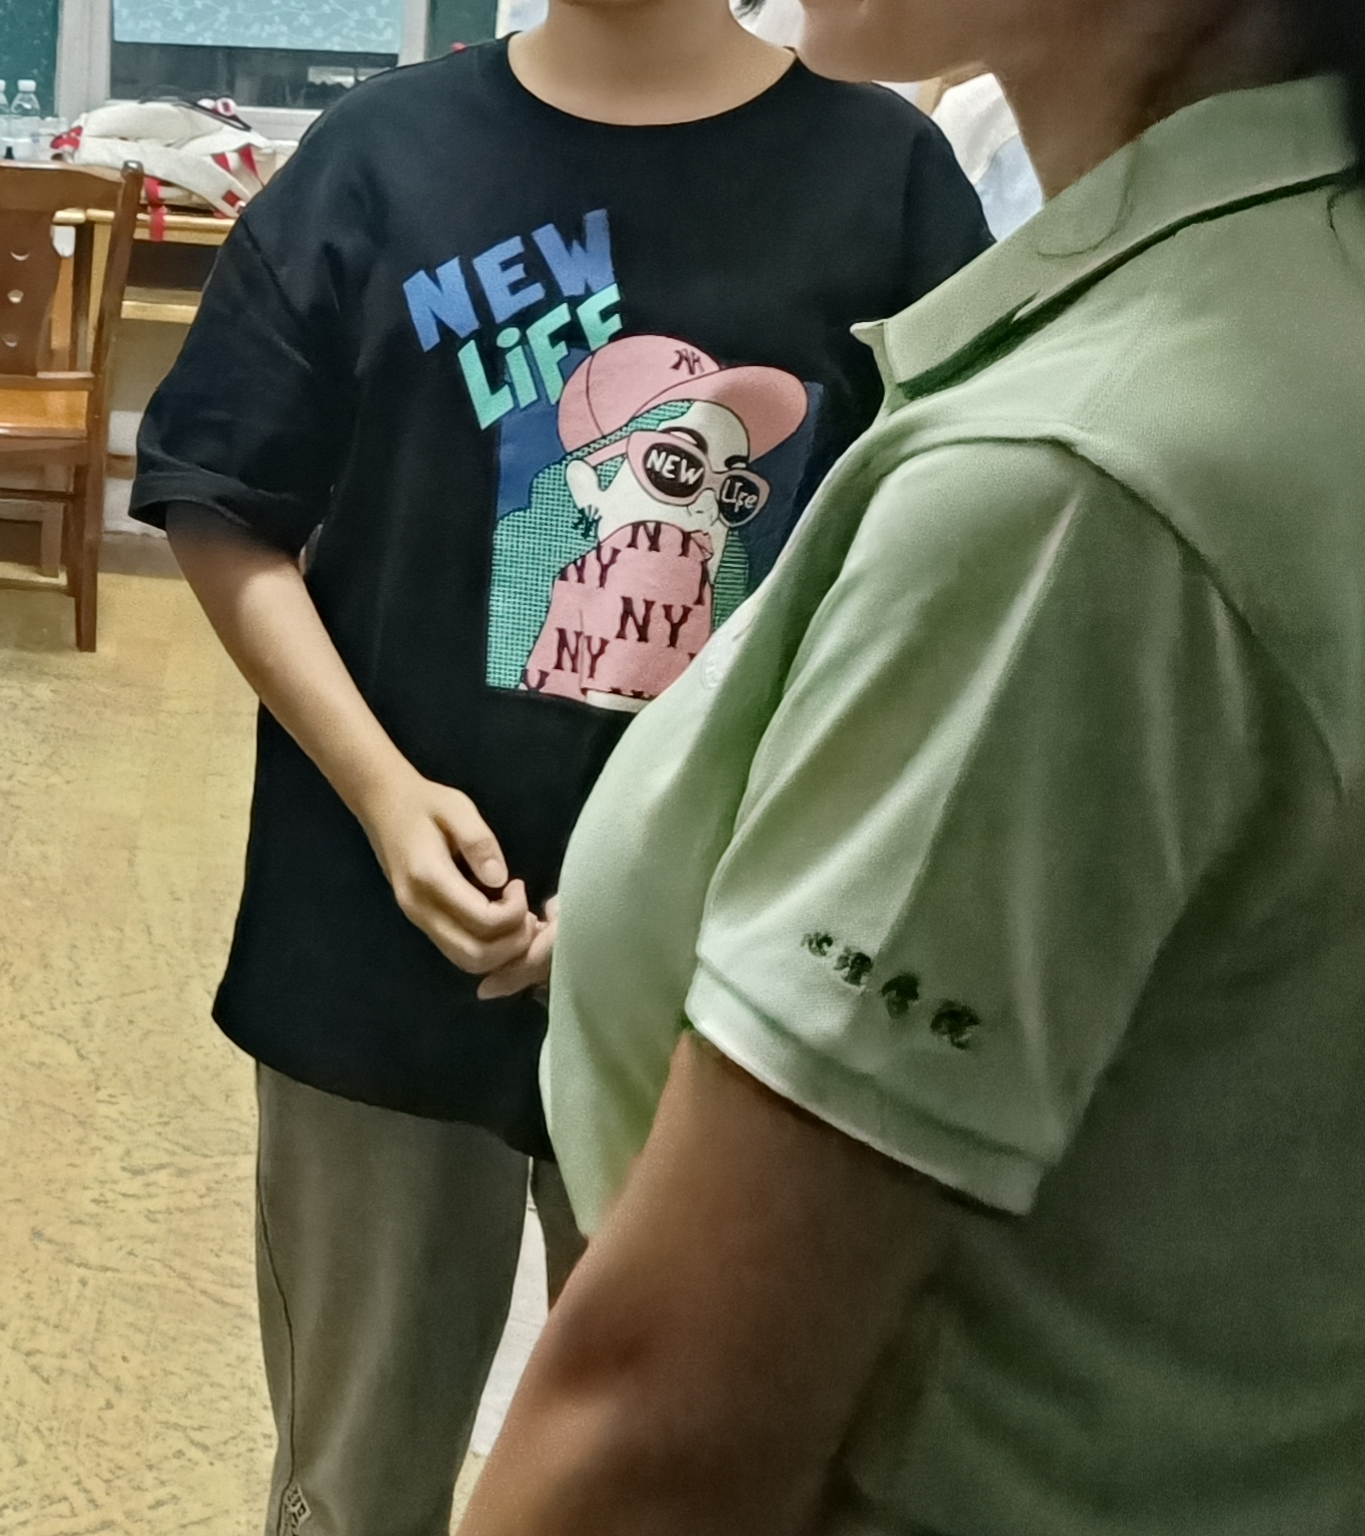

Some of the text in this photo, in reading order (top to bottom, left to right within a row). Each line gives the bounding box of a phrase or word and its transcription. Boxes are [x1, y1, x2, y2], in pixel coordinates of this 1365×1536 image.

[402, 207, 617, 353] NEW
[644, 448, 706, 486] NEW
[615, 595, 694, 648] NY
[553, 627, 610, 679] NY
